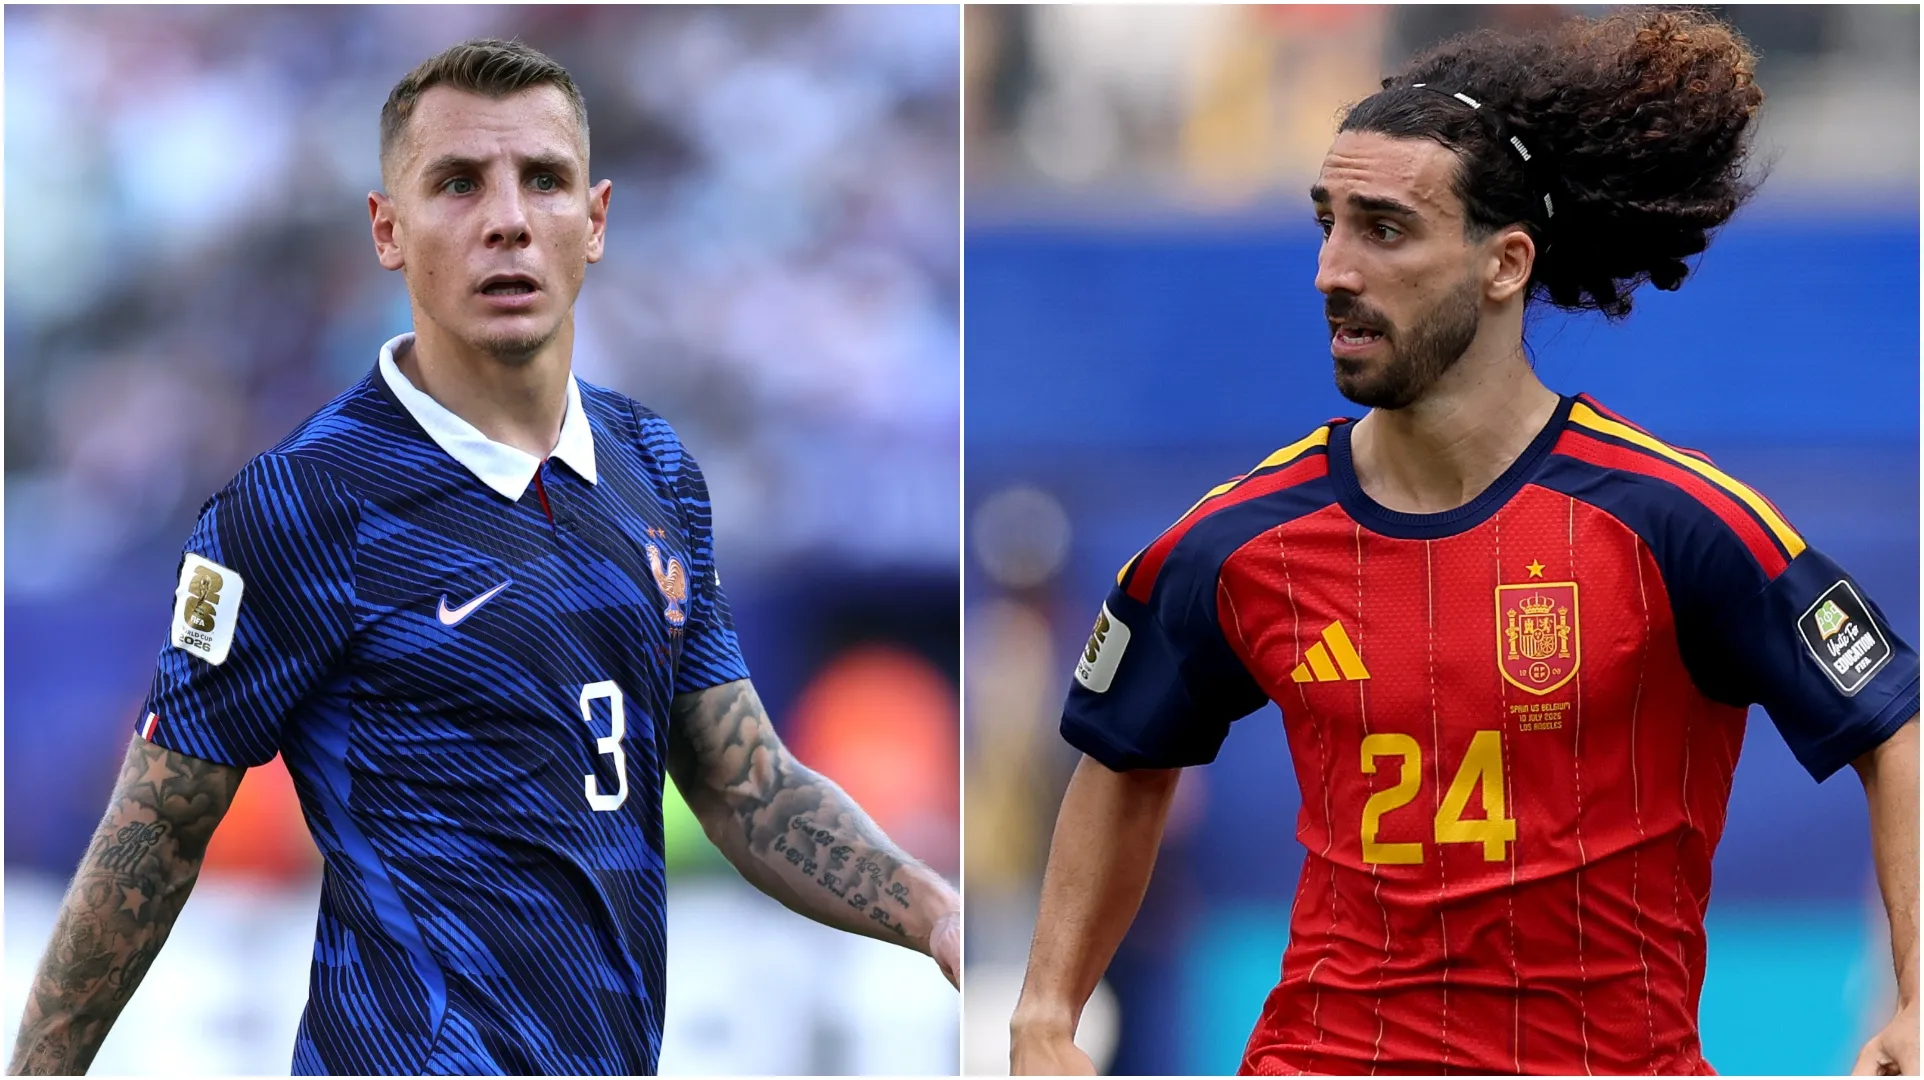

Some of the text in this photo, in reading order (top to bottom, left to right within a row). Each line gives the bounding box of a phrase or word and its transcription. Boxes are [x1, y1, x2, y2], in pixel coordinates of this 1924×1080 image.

[1510, 136, 1532, 162] PUMA
[200, 634, 213, 642] CUP
[1844, 622, 1860, 641] For
[179, 634, 211, 652] 2026
[1833, 631, 1876, 675] EDUCATION
[1854, 656, 1873, 674] FIFA
[1510, 705, 1529, 714] SPAIN
[1541, 702, 1570, 712] BELGIUM
[1528, 713, 1542, 721] JULY
[1543, 712, 1561, 721] 2026
[1519, 723, 1531, 731] LOS
[579, 679, 629, 812] 3
[1360, 730, 1517, 865] 24
